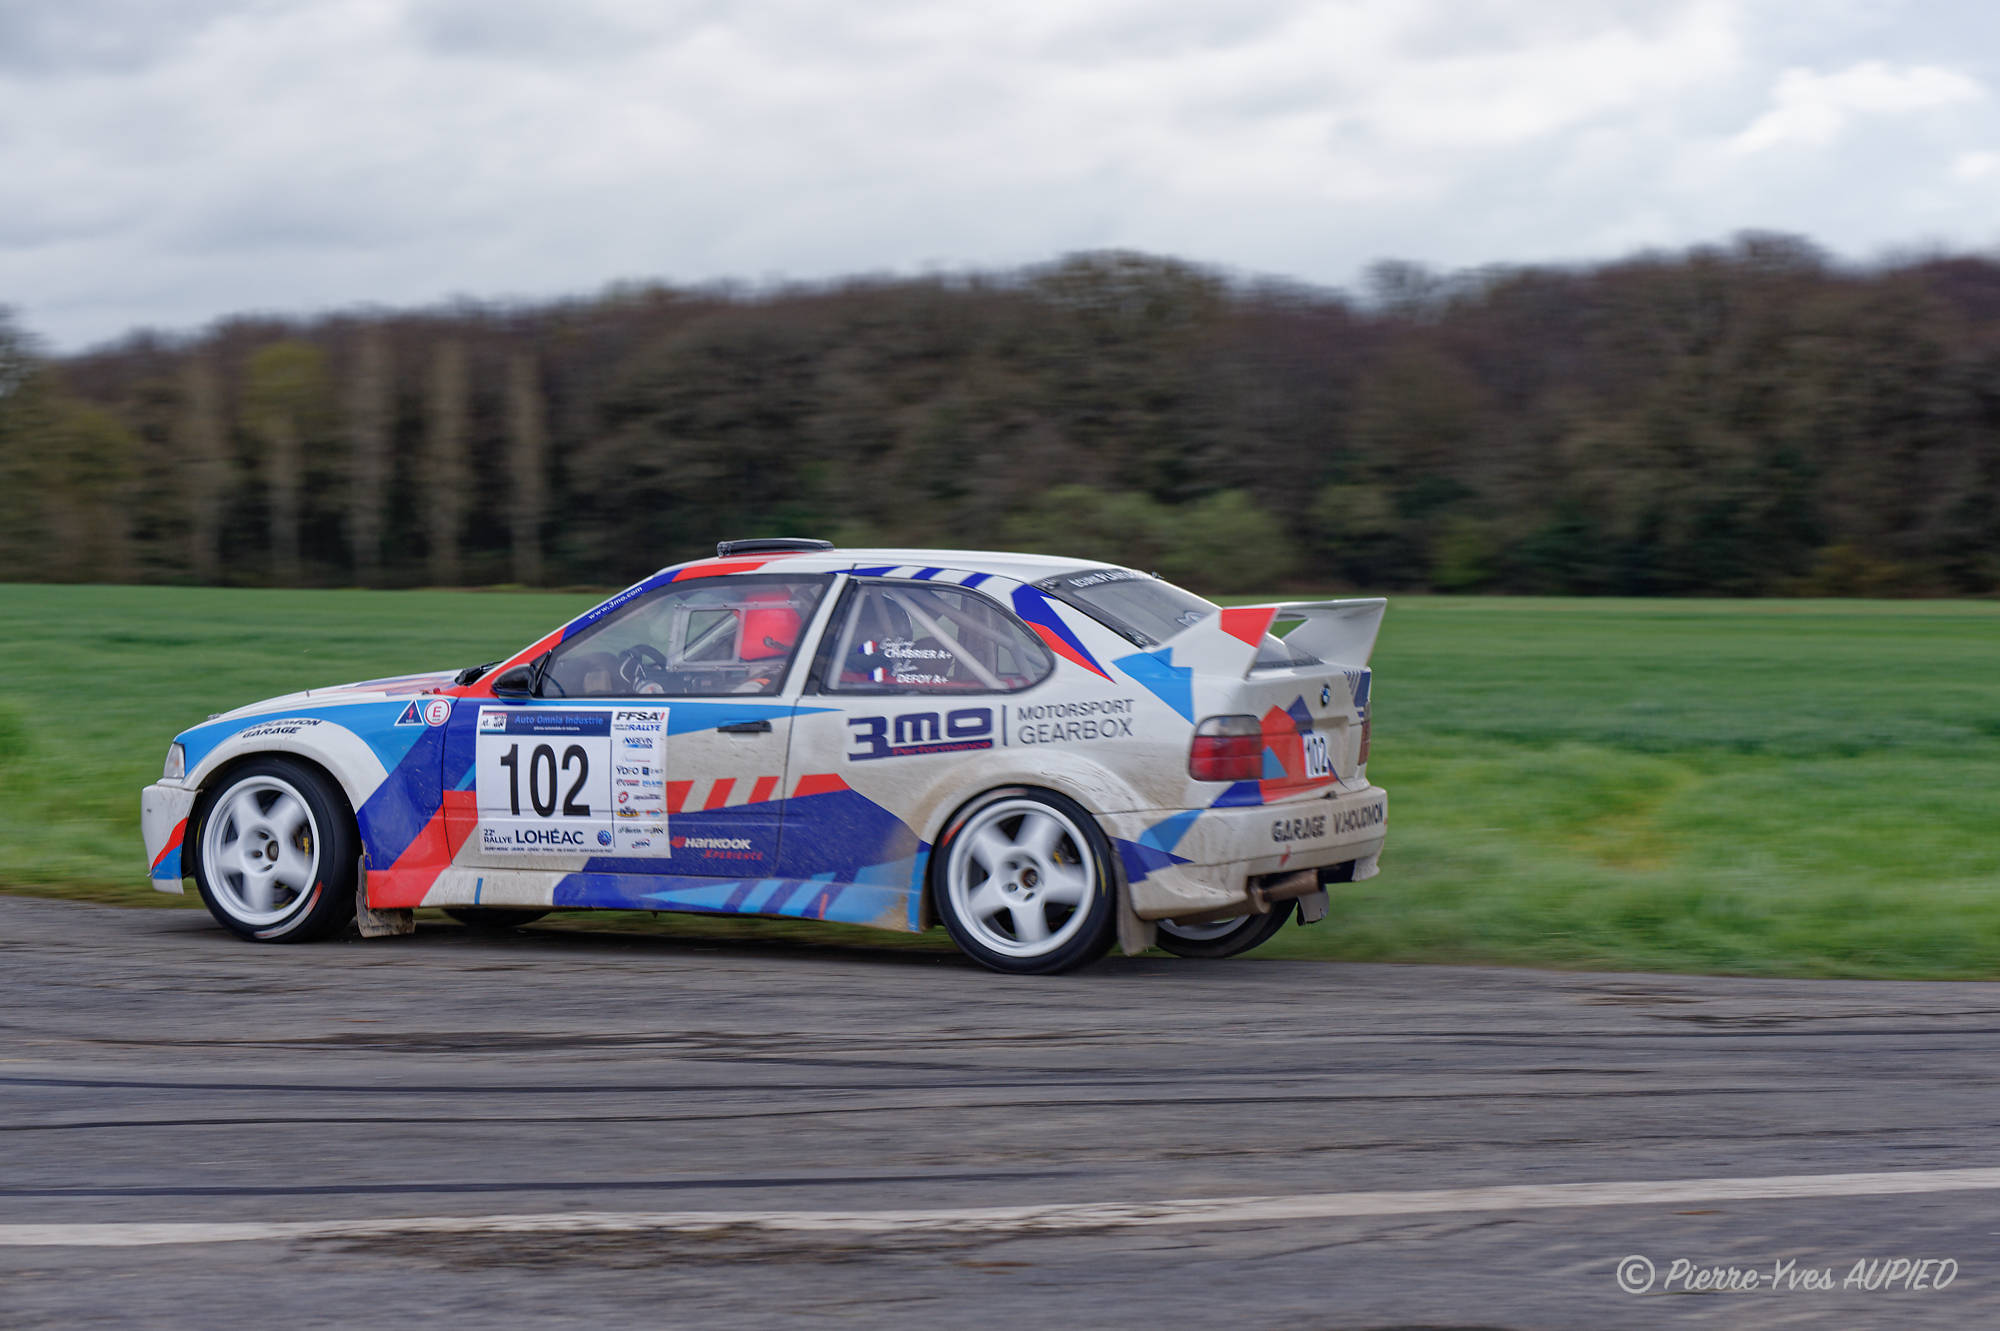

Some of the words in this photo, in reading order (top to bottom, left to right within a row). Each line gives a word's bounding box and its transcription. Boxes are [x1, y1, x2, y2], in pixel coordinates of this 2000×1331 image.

[588, 586, 644, 620] www.3mo.com
[432, 706, 442, 718] E
[616, 711, 659, 720] FFSA
[1017, 700, 1134, 721] MOTORSPORT
[514, 715, 535, 724] Auto
[537, 715, 563, 724] Omnia
[565, 715, 604, 725] Industrie
[629, 724, 662, 732] RALLYE
[242, 726, 303, 738] GARAGE
[1017, 718, 1134, 745] GEARBOX
[1307, 736, 1328, 774] 102
[500, 743, 591, 817] 102
[515, 828, 585, 845] LOHÉAC
[1271, 815, 1327, 842] GARAGE
[483, 836, 513, 844] RALLYE
